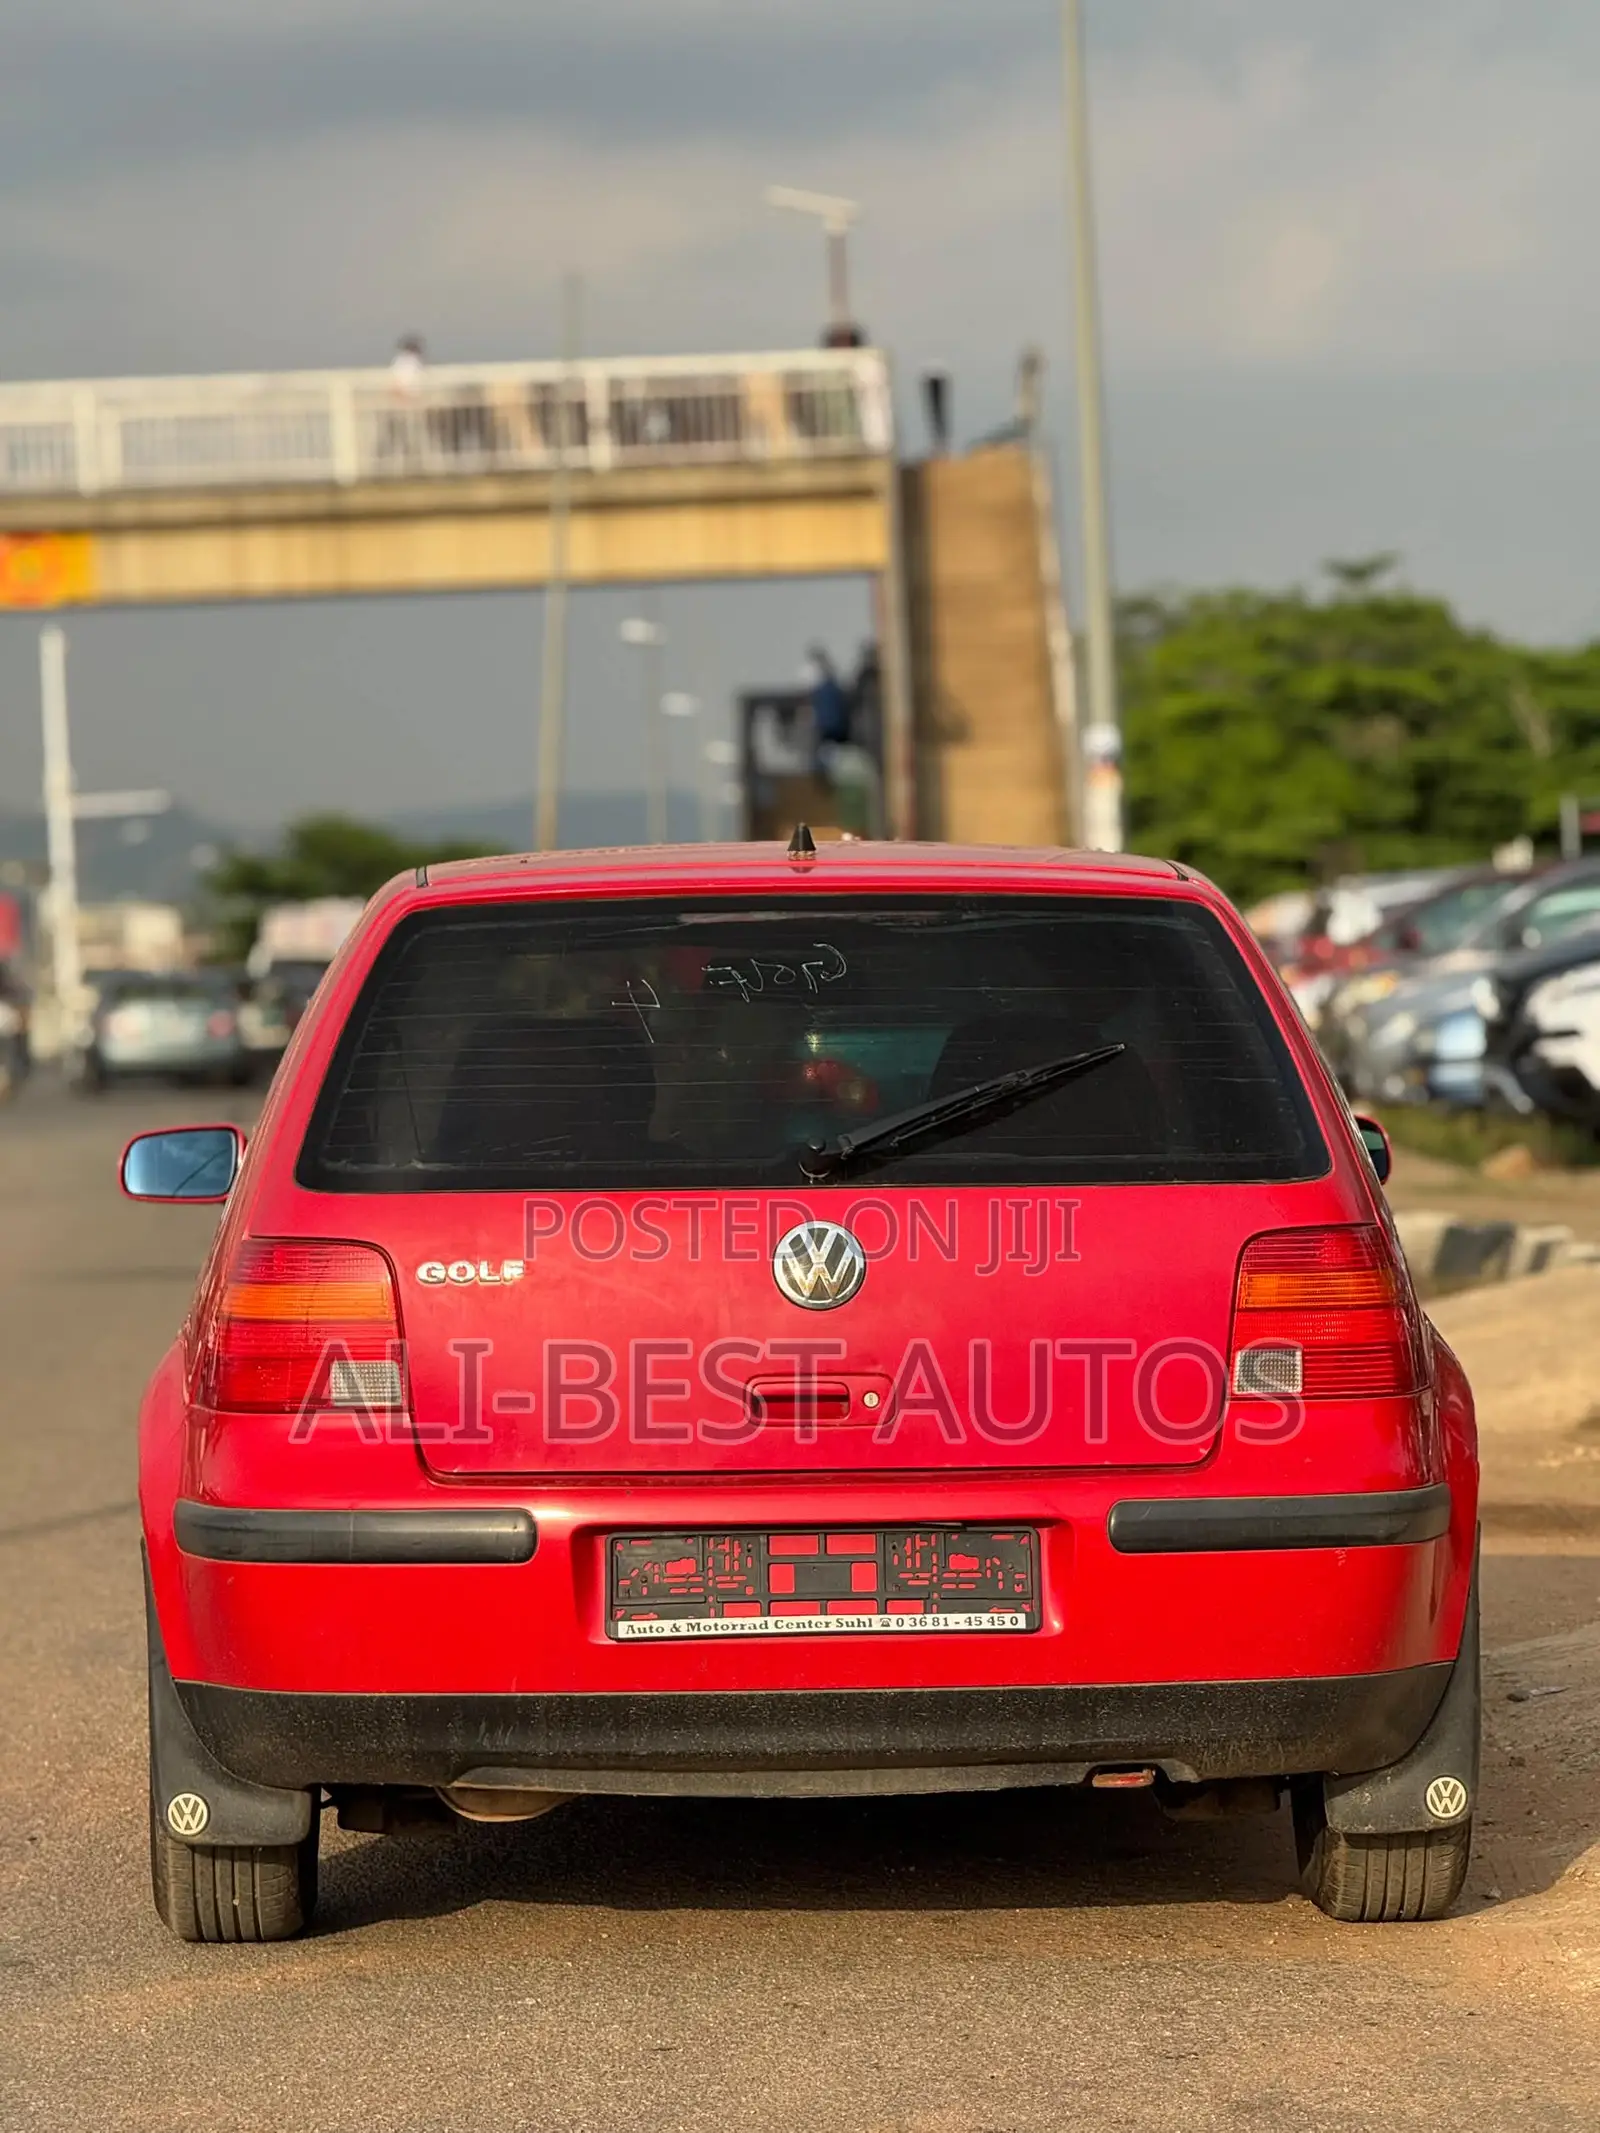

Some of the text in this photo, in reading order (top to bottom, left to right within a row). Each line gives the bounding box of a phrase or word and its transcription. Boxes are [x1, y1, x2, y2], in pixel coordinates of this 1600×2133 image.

[416, 1259, 524, 1284] GOLF
[773, 1220, 867, 1310] VW
[625, 1620, 665, 1635] Auto
[669, 1620, 682, 1633] &
[686, 1619, 769, 1633] Motorrad
[774, 1618, 832, 1630] Center
[835, 1617, 873, 1628] Suhl
[167, 1792, 209, 1836] VW
[1425, 1775, 1468, 1819] VW
